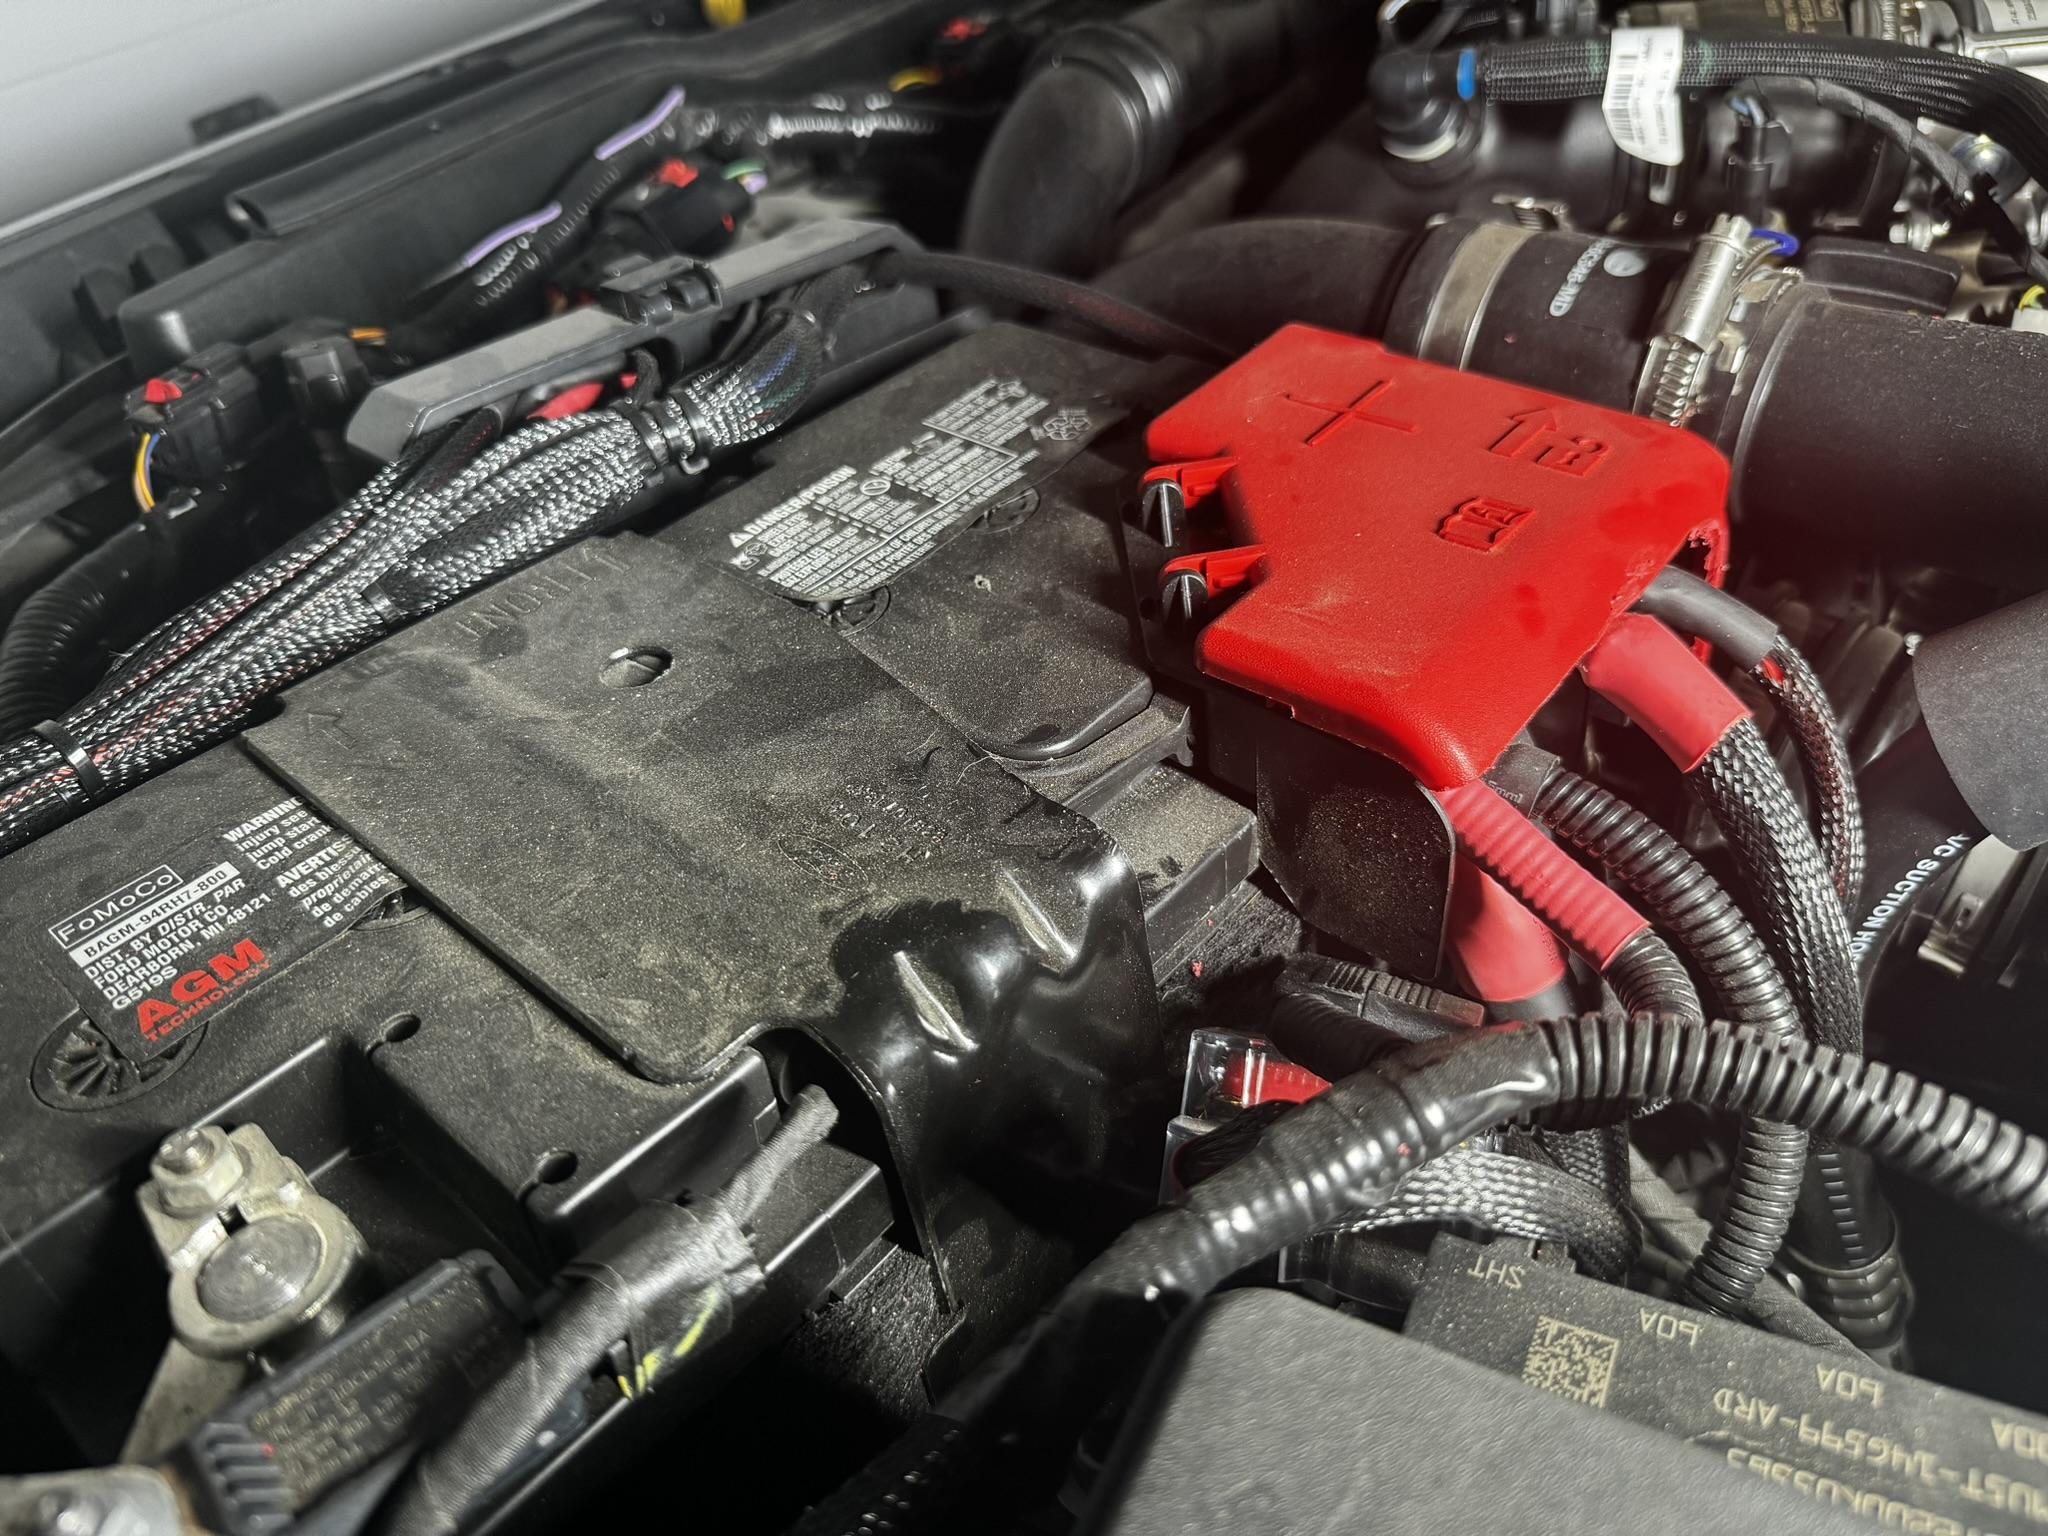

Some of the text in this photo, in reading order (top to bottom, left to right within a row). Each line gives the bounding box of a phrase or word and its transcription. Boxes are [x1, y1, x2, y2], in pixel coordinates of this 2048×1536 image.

[742, 463, 858, 537] DANGER/POISON
[235, 809, 308, 852] injury see
[246, 816, 322, 863] jump start
[256, 847, 293, 870] Cold
[58, 874, 173, 942] FoMoCo
[84, 869, 228, 958] BAGM-94RH7-800
[289, 874, 318, 899] des
[311, 902, 332, 917] de
[322, 876, 389, 928] de cables
[1862, 858, 1940, 928] SUCTION
[84, 878, 246, 979] DIST. BY DISTR. PAR
[93, 904, 234, 990] FORD MOTOR CO.
[103, 893, 271, 1000] DEARBORN, MI 48121
[112, 965, 178, 1010] G519S
[137, 938, 264, 1034] AGM
[145, 960, 272, 1041] TECHNOLOGY
